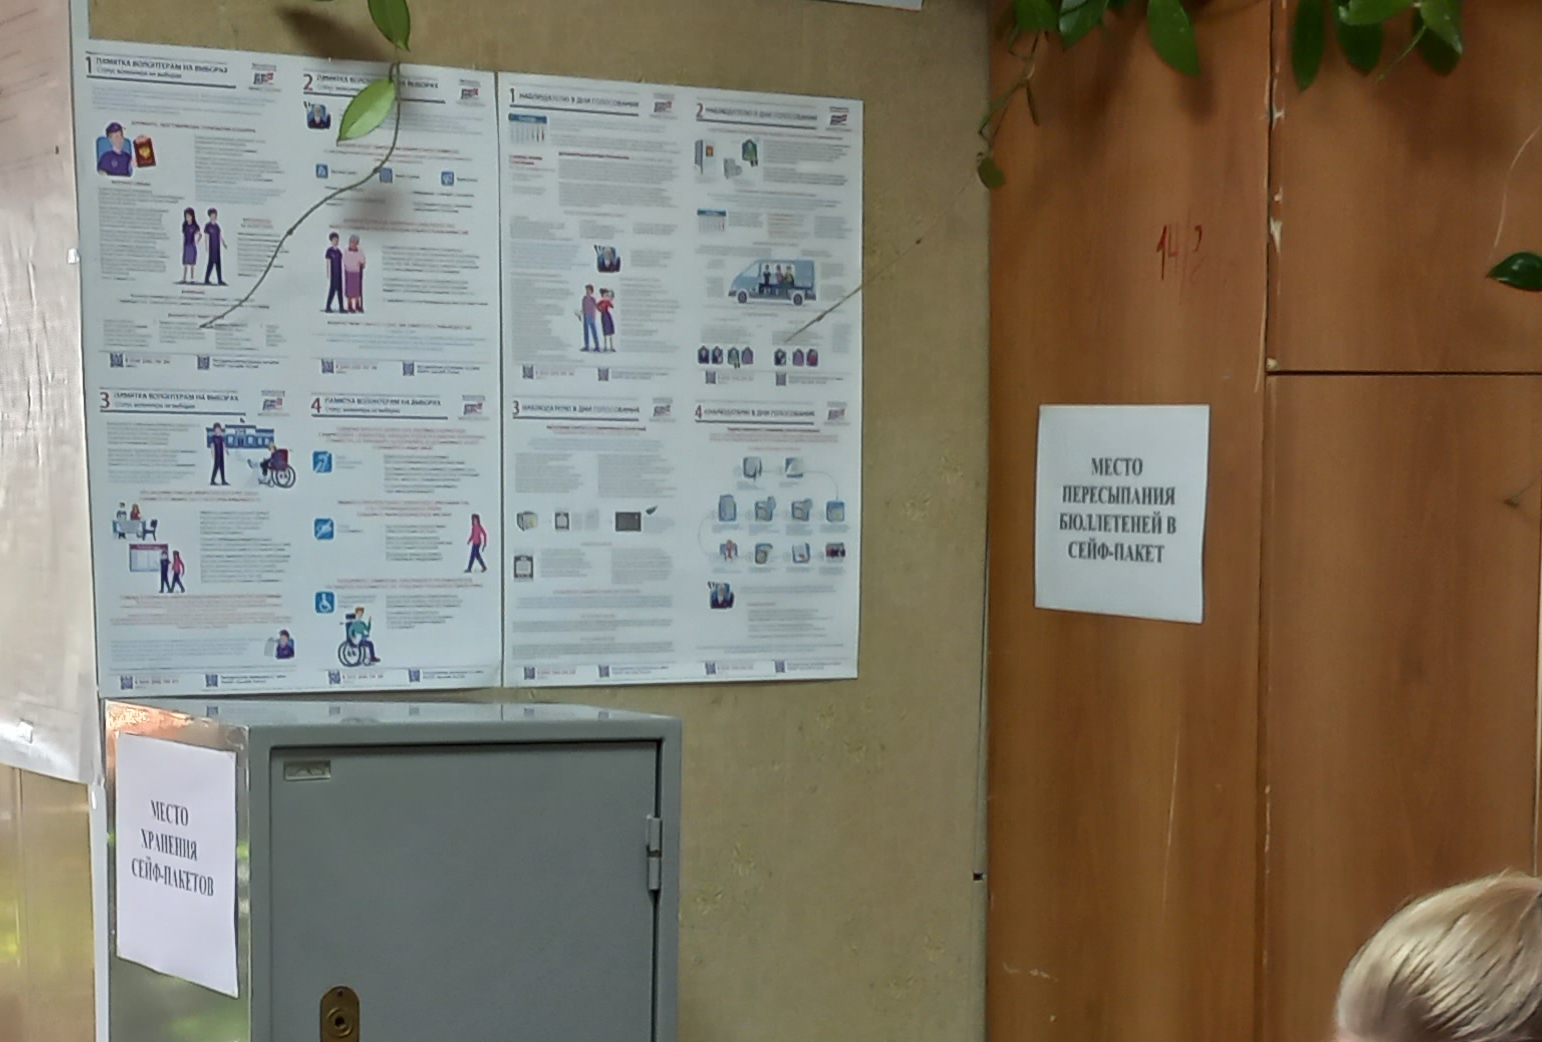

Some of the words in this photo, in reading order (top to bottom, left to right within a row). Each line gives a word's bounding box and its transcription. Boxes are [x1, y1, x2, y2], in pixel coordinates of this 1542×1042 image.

[85, 55, 92, 74] 1
[303, 74, 313, 91] 2
[696, 102, 704, 118] 2
[100, 391, 110, 409] 3
[311, 397, 322, 413] 4
[512, 400, 520, 415] 3
[695, 404, 703, 419] 4
[1091, 457, 1144, 476] МЕСТО
[1062, 485, 1176, 506] ПЕРЕСЫПАНИЯ
[1059, 511, 1162, 534] БЮЛЛЕТЕНЕЙ
[1167, 515, 1177, 534] В
[1068, 537, 1165, 563] СЕЙФ-ПАКЕТ
[150, 799, 189, 826] МЕСТО
[141, 828, 198, 861] ХРАНЕНИЯ
[131, 855, 214, 897] СЕЙФ-ПАКЕТОВ
